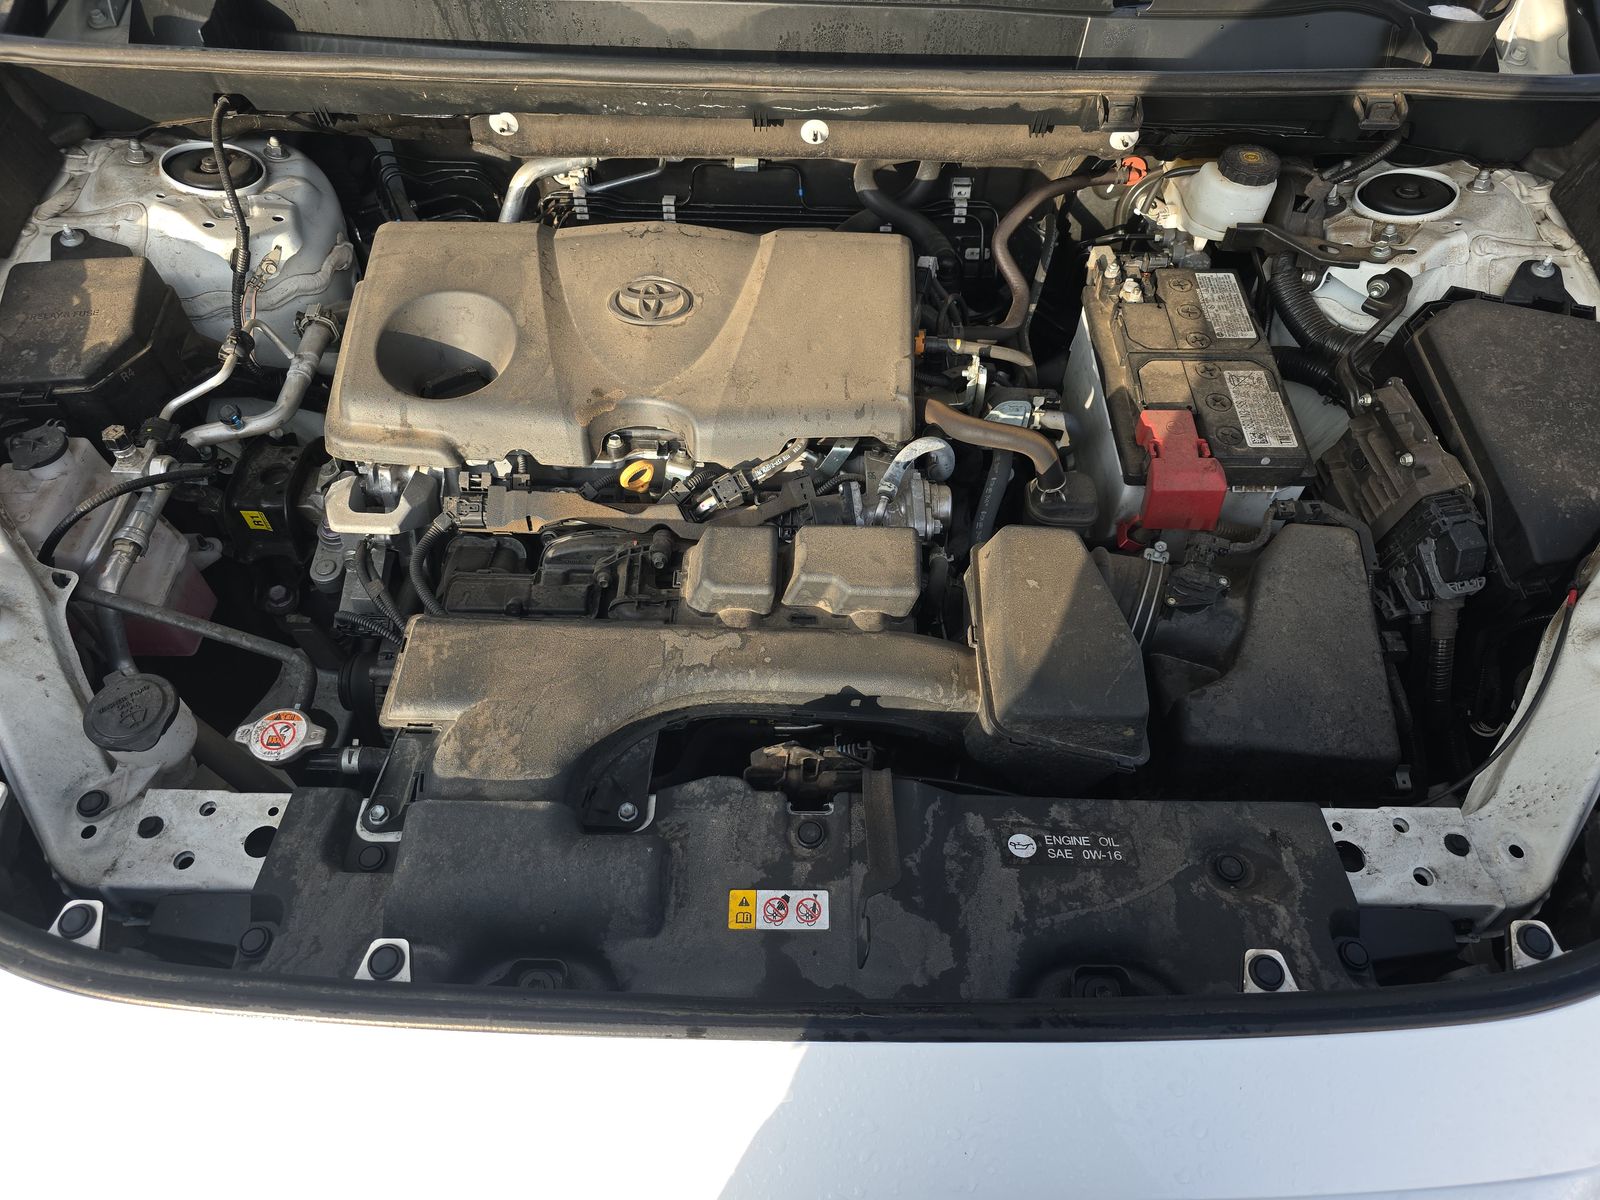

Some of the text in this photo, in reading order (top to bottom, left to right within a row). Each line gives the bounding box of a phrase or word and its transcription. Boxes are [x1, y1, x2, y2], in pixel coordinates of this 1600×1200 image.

[120, 367, 136, 383] R4
[250, 515, 264, 526] R1
[1044, 835, 1120, 848] ENGINE OIL
[1047, 848, 1123, 861] SAE 0W-16
